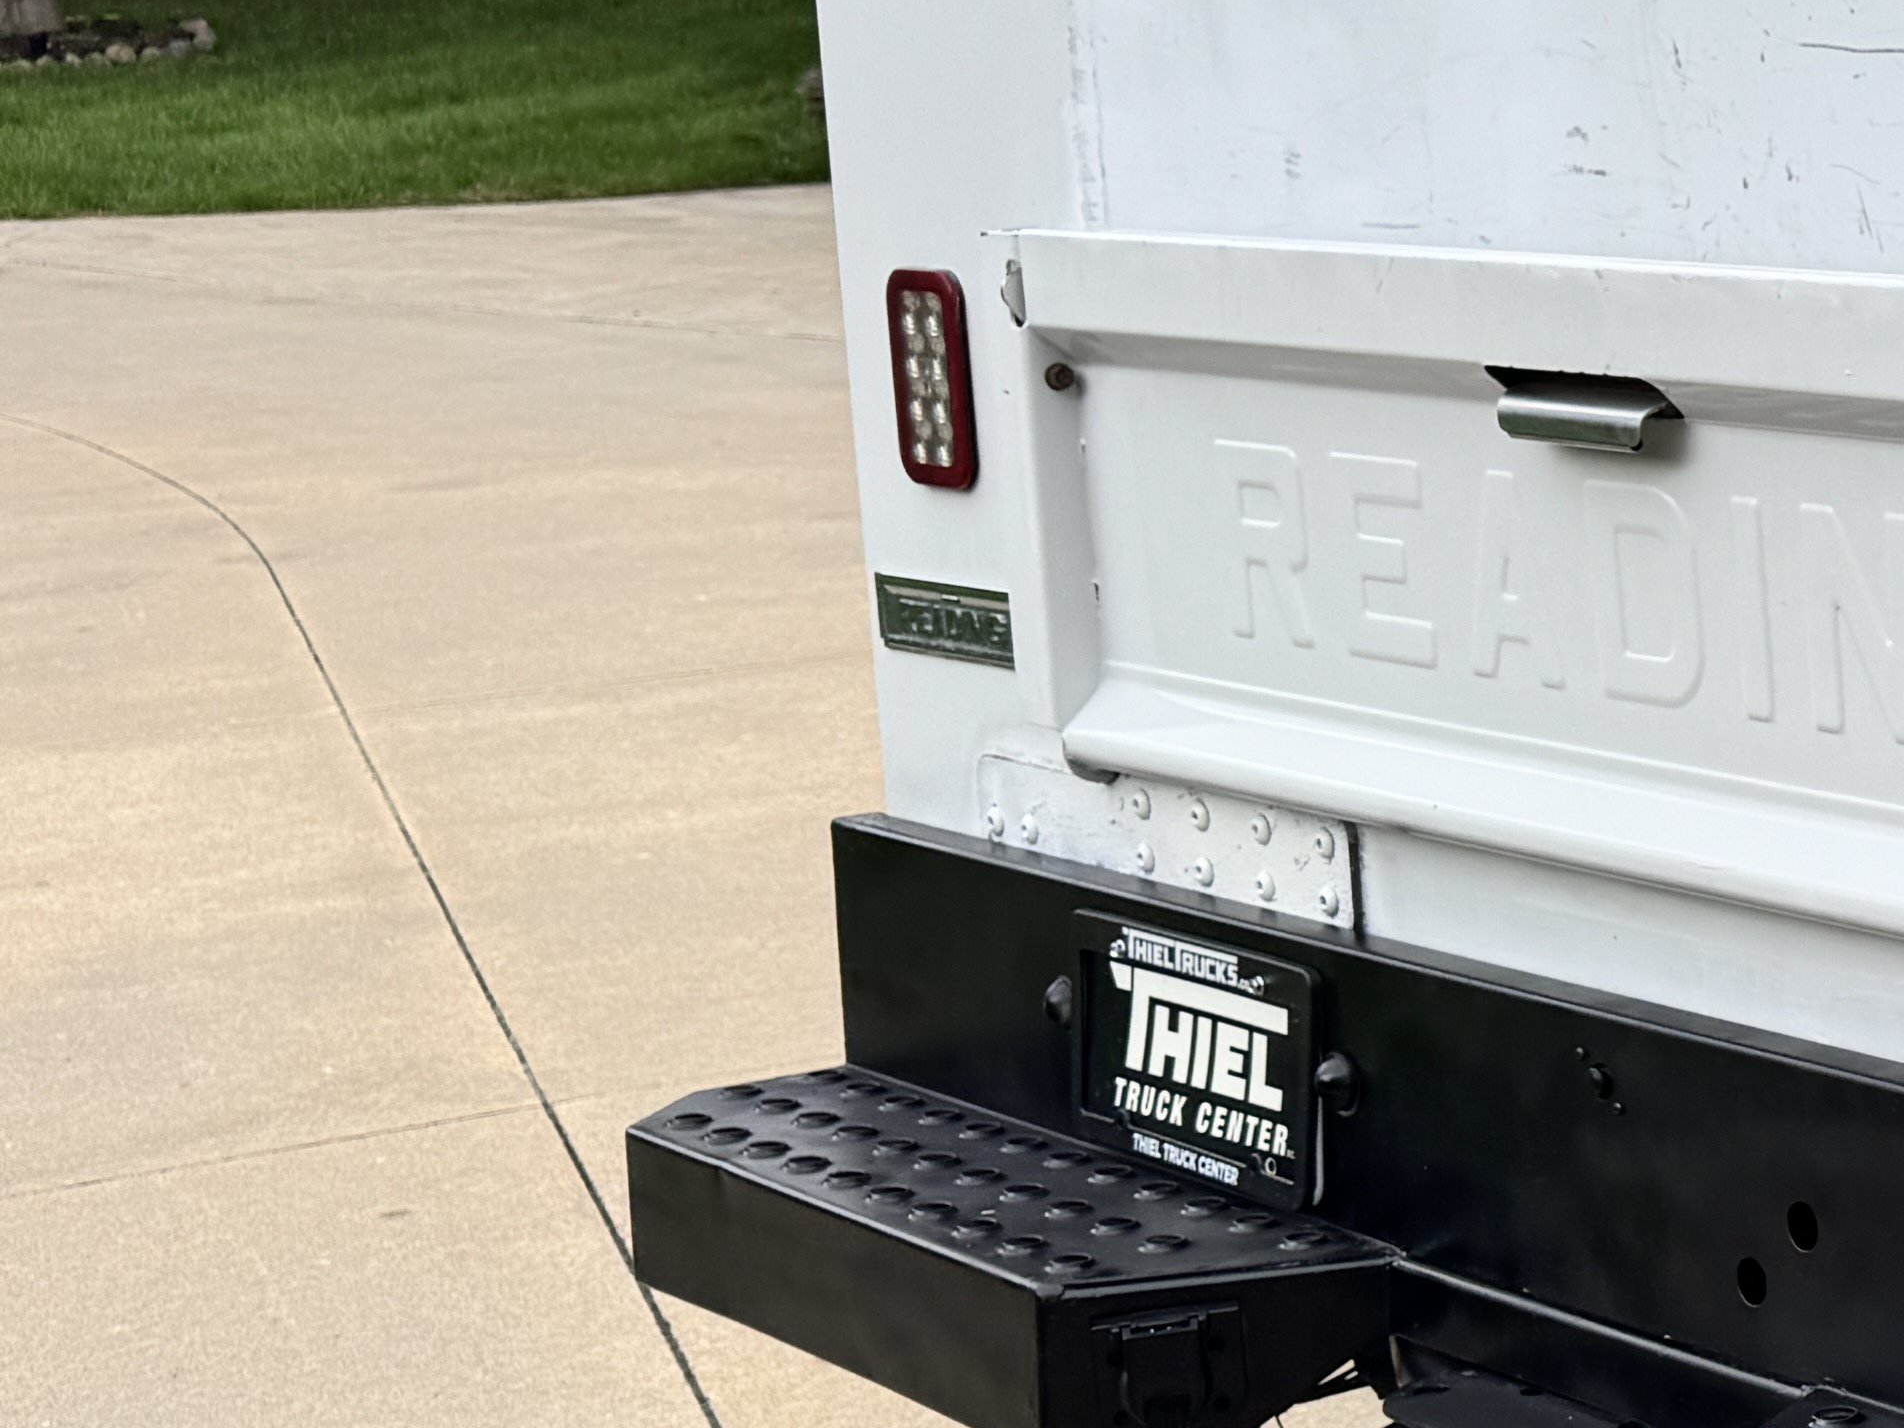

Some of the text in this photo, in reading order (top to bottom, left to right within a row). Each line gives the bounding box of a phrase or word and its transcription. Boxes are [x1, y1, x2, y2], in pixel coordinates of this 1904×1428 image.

[1109, 961, 1289, 1113] THIEL
[1113, 1076, 1289, 1156] TRUCK CENTER
[1131, 1132, 1240, 1187] THIEL TRUCK CENTER
